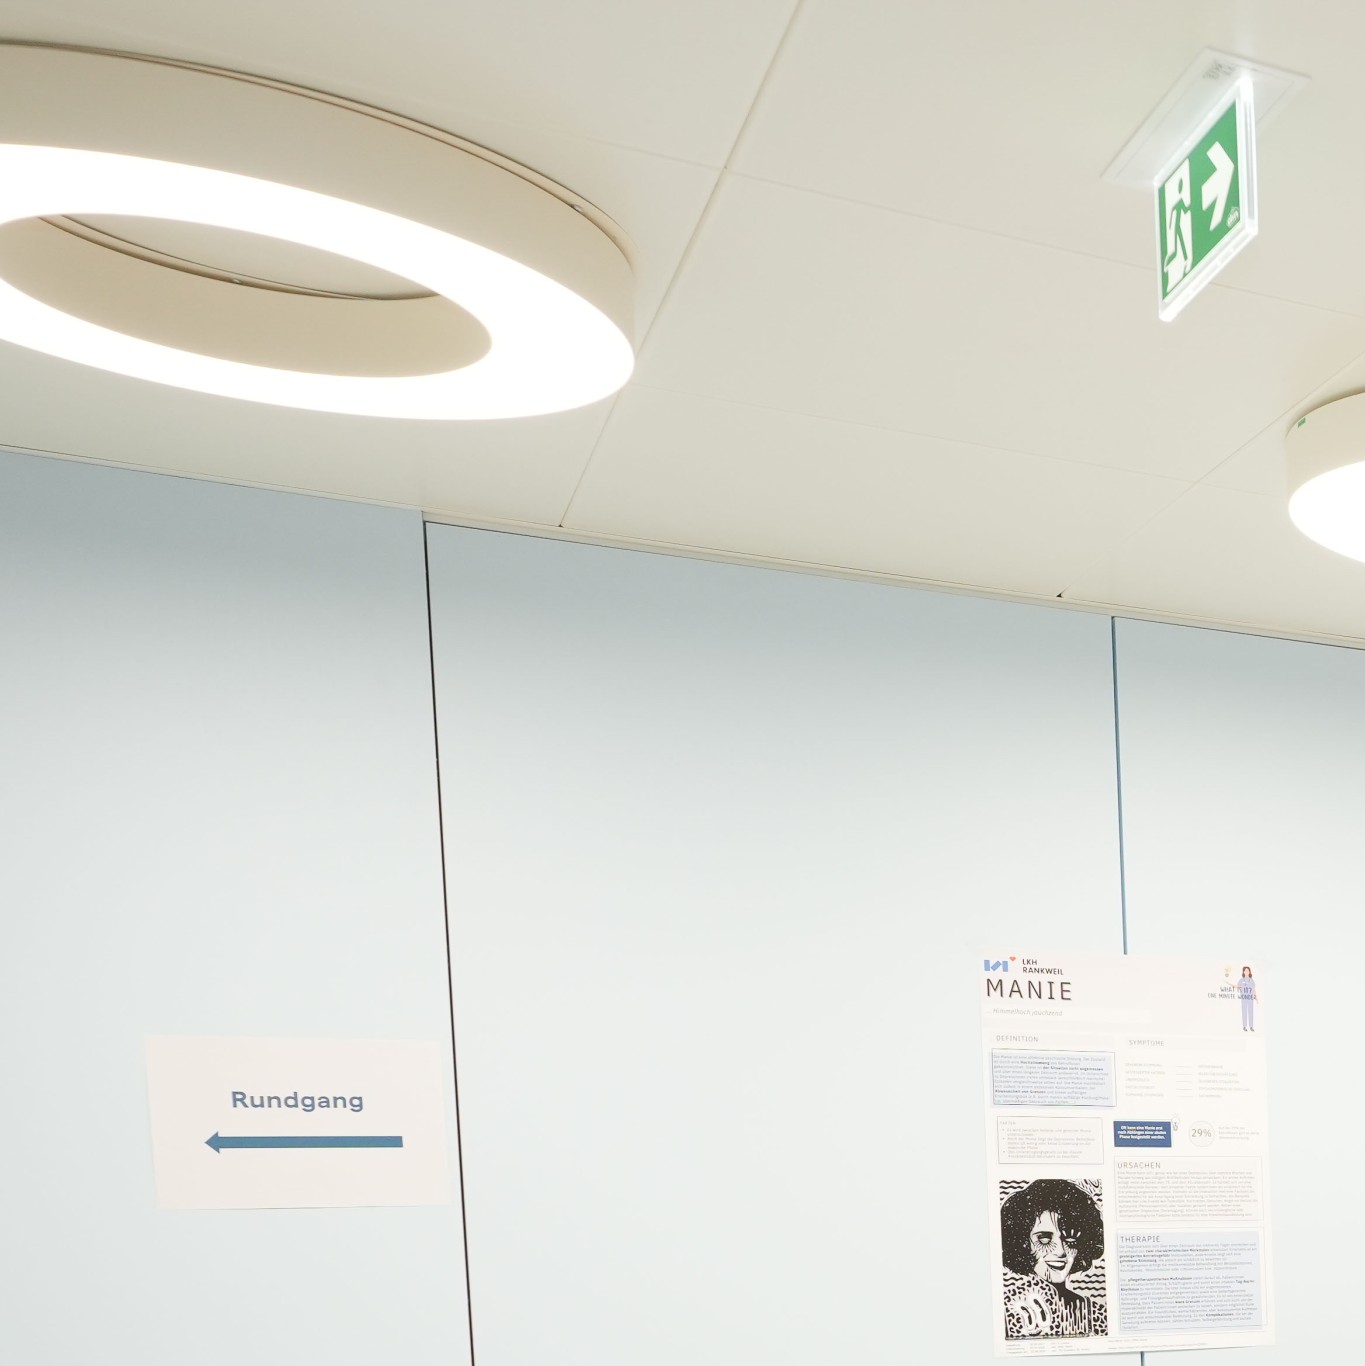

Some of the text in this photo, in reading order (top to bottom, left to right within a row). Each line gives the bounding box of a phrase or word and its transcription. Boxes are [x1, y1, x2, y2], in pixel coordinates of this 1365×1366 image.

[1022, 958, 1038, 966] LKH
[1022, 966, 1064, 976] RANKWEIL
[986, 978, 1072, 1001] MANIE
[996, 1034, 1039, 1043] DEFINITION
[1128, 1039, 1165, 1047] SYMPTOME
[231, 1091, 364, 1112] Rundgang
[1191, 1128, 1212, 1138] 29%
[1117, 1161, 1161, 1169] URSACHEN
[1120, 1235, 1161, 1243] THERAPIE
